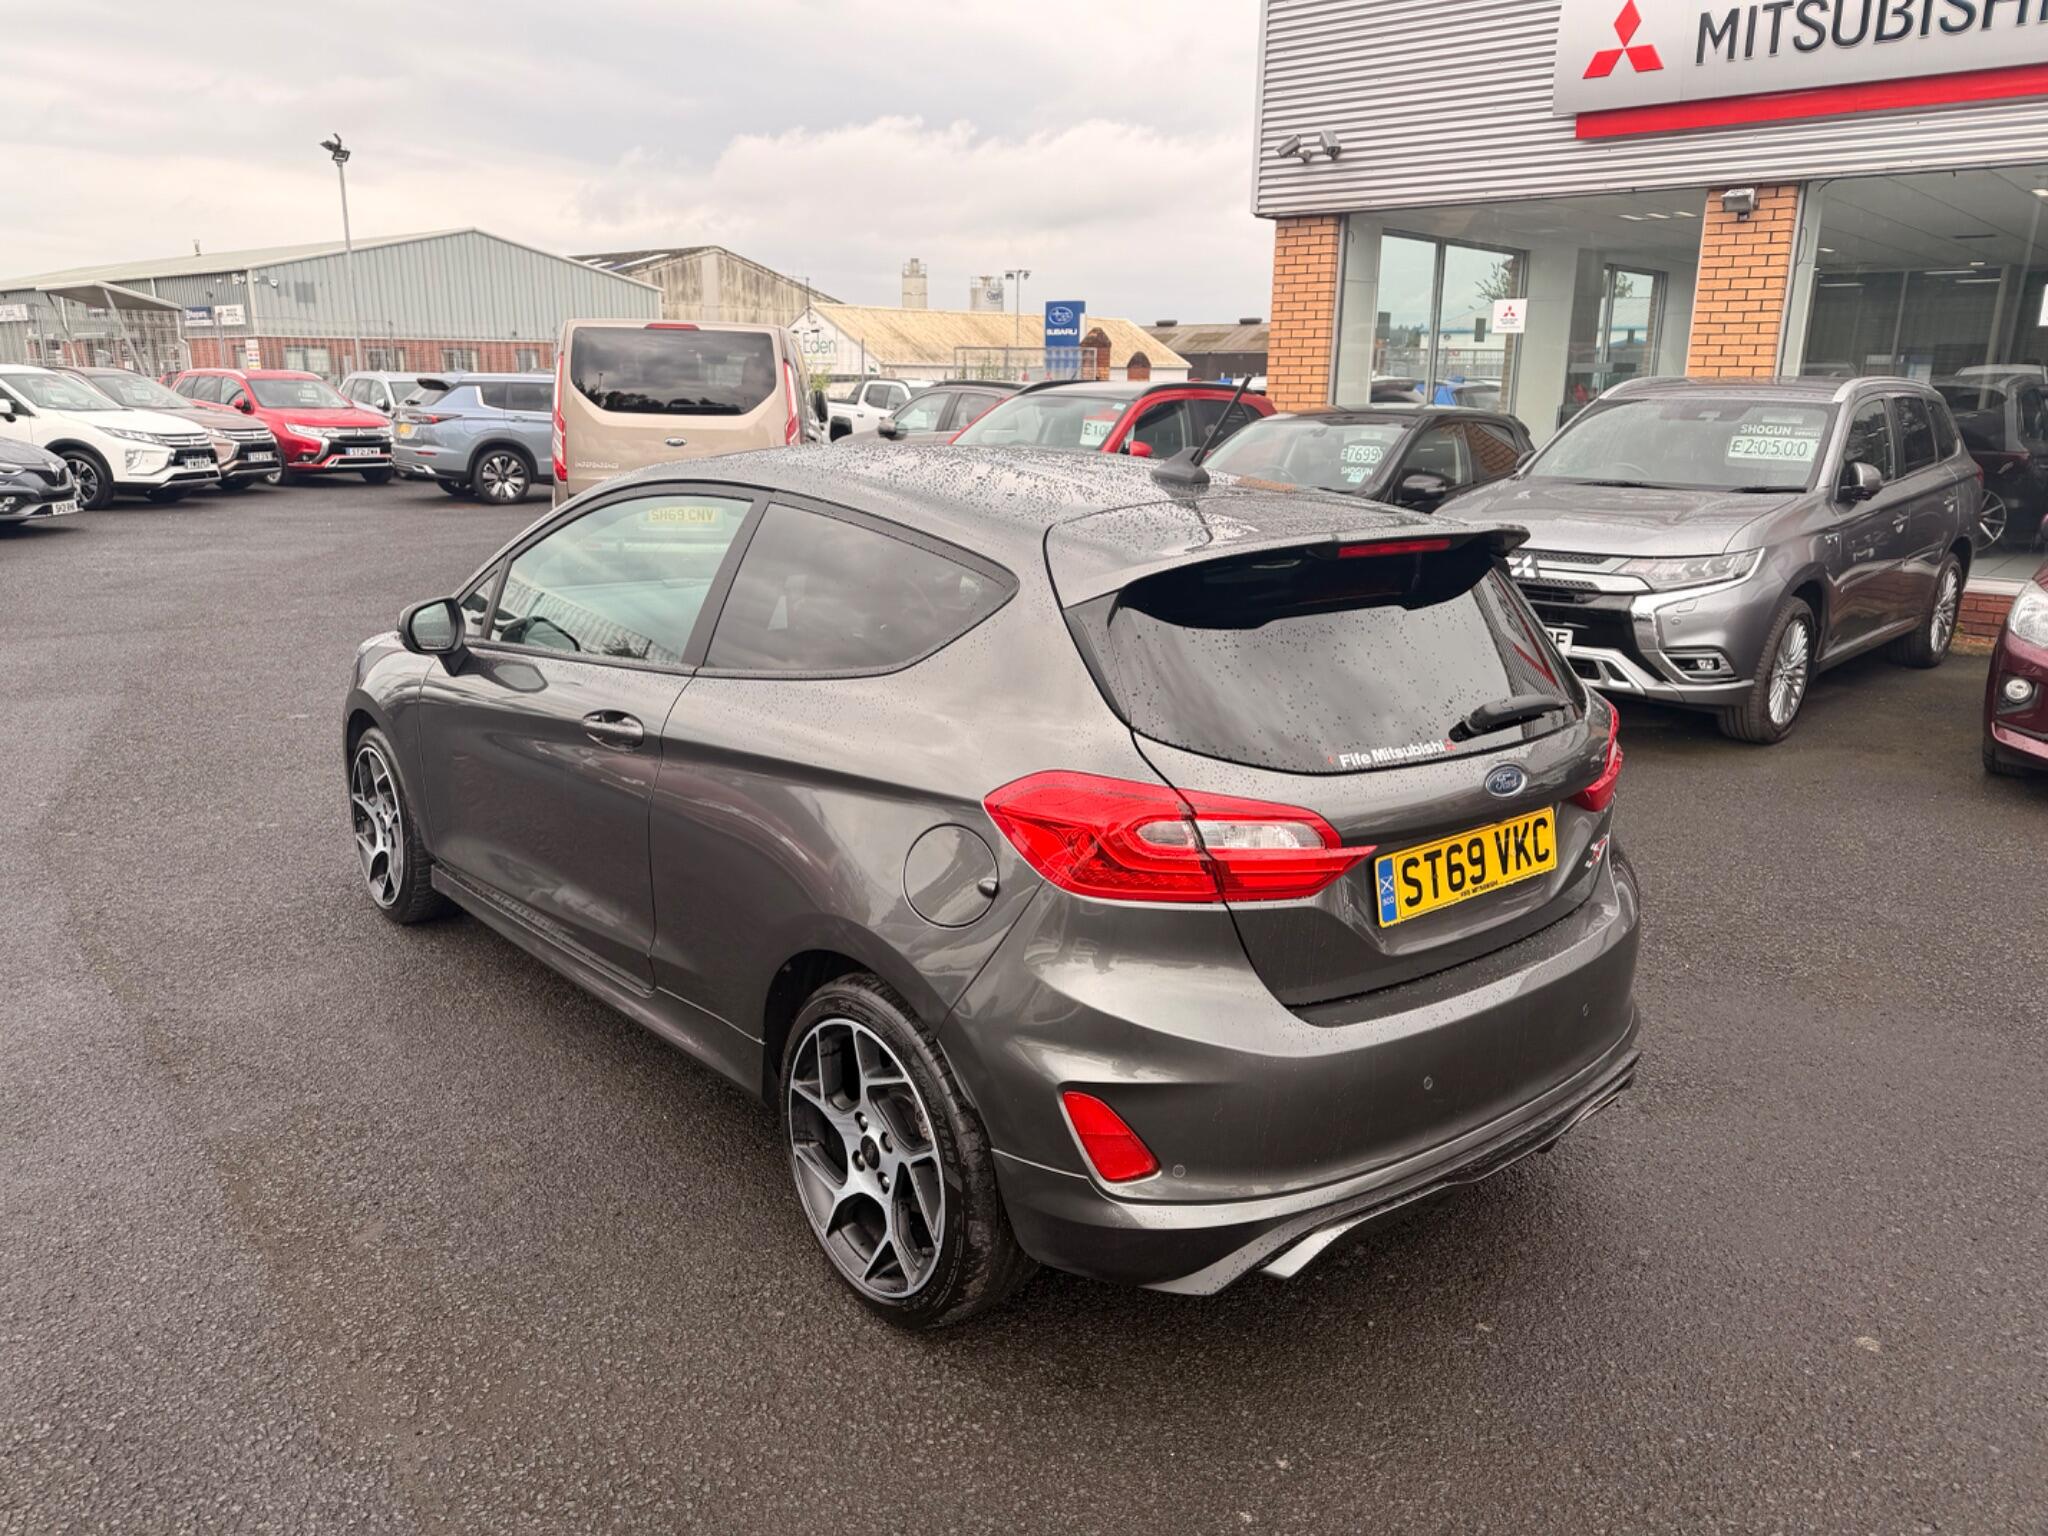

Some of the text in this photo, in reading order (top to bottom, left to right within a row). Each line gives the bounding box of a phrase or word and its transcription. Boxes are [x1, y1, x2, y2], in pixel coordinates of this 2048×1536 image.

[803, 332, 836, 354] Eden
[1046, 328, 1078, 336] SUBARU
[1741, 423, 1792, 436] SHOGUN
[1339, 739, 1446, 768] Fife Mitsubishi
[1401, 817, 1548, 908] ST69 VKC
